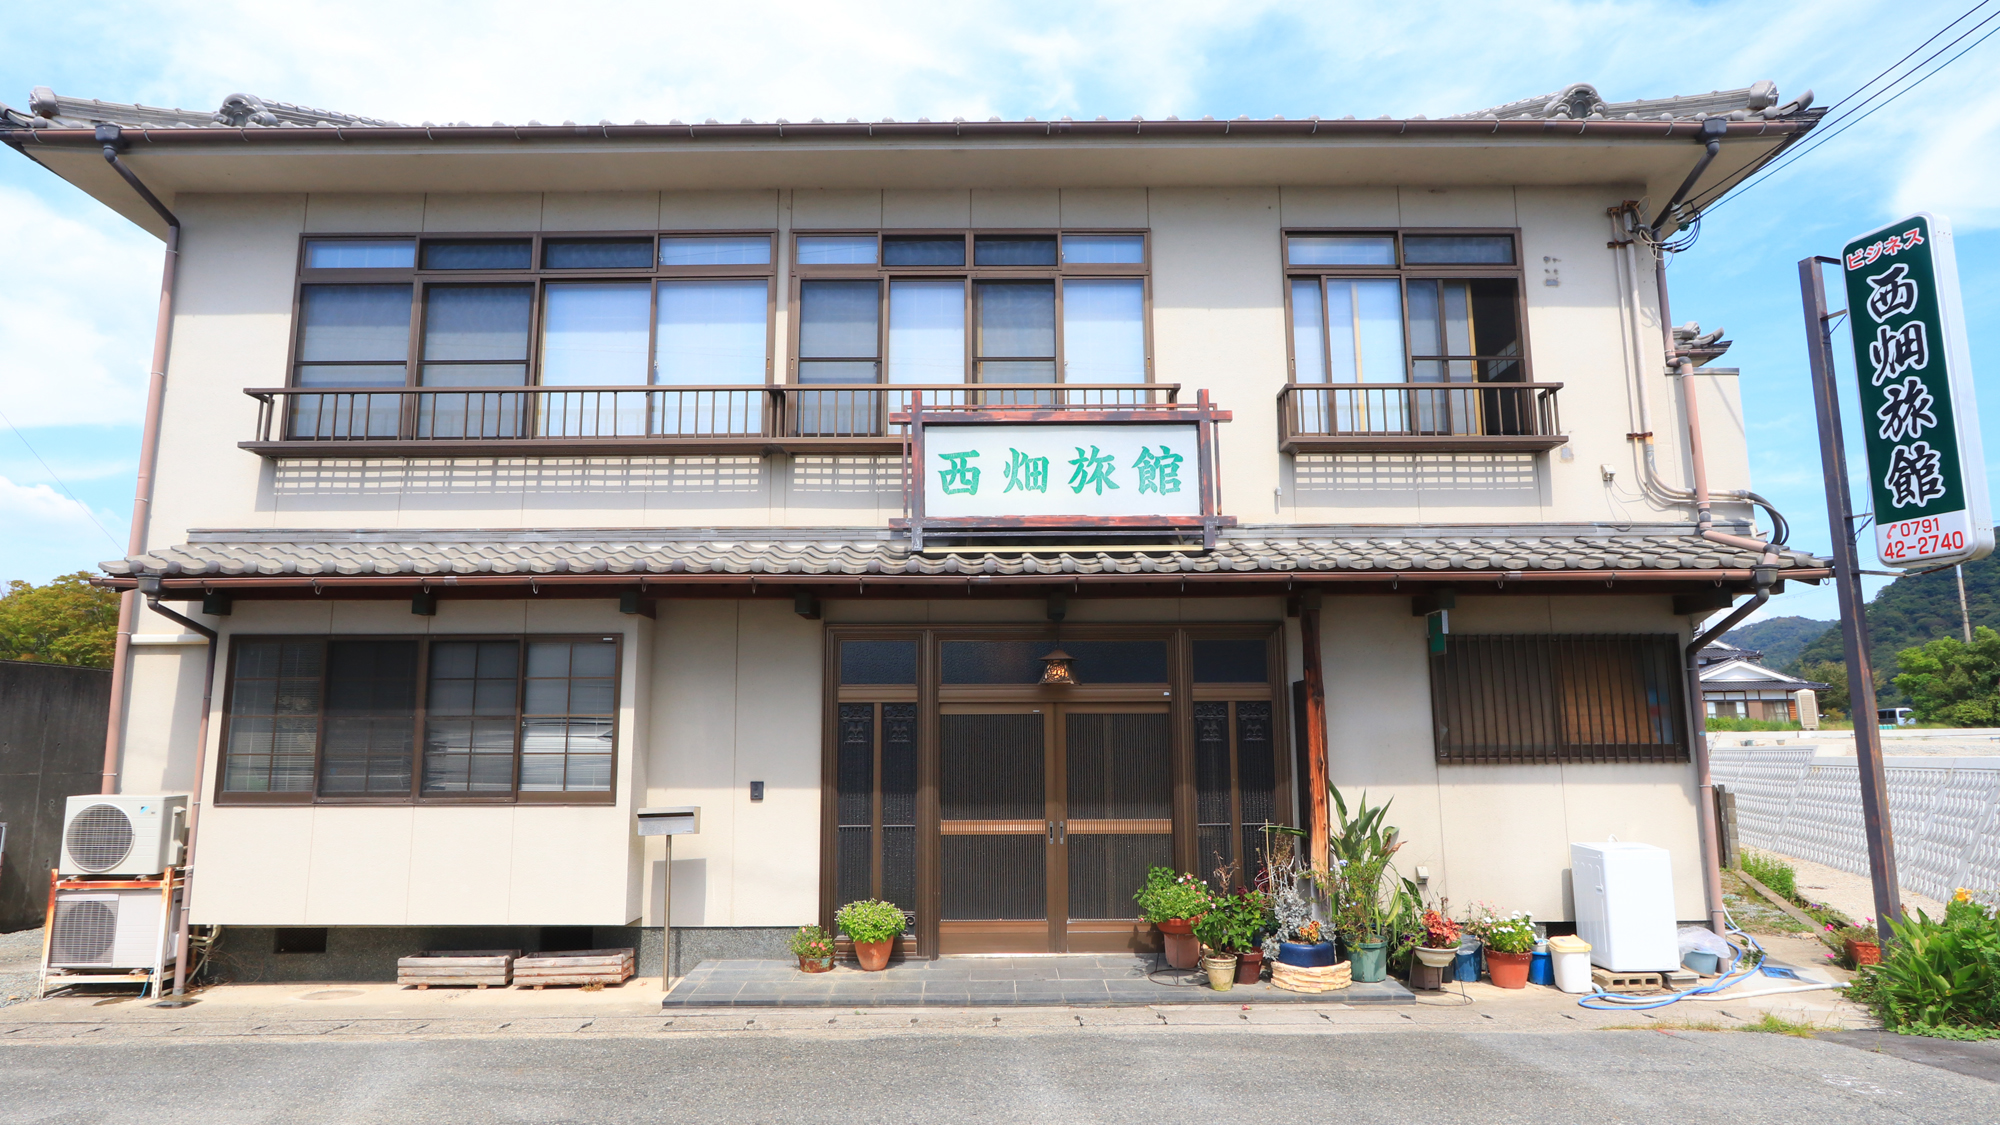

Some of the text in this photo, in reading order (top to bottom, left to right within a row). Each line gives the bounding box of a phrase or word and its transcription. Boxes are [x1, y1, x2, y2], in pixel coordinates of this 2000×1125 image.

[1847, 228, 1924, 269] ビジネス
[1867, 263, 1946, 508] 西畑旅館
[937, 445, 1184, 496] 西畑旅館
[1884, 531, 1964, 559] 42-2740
[1900, 518, 1940, 537] 0791
